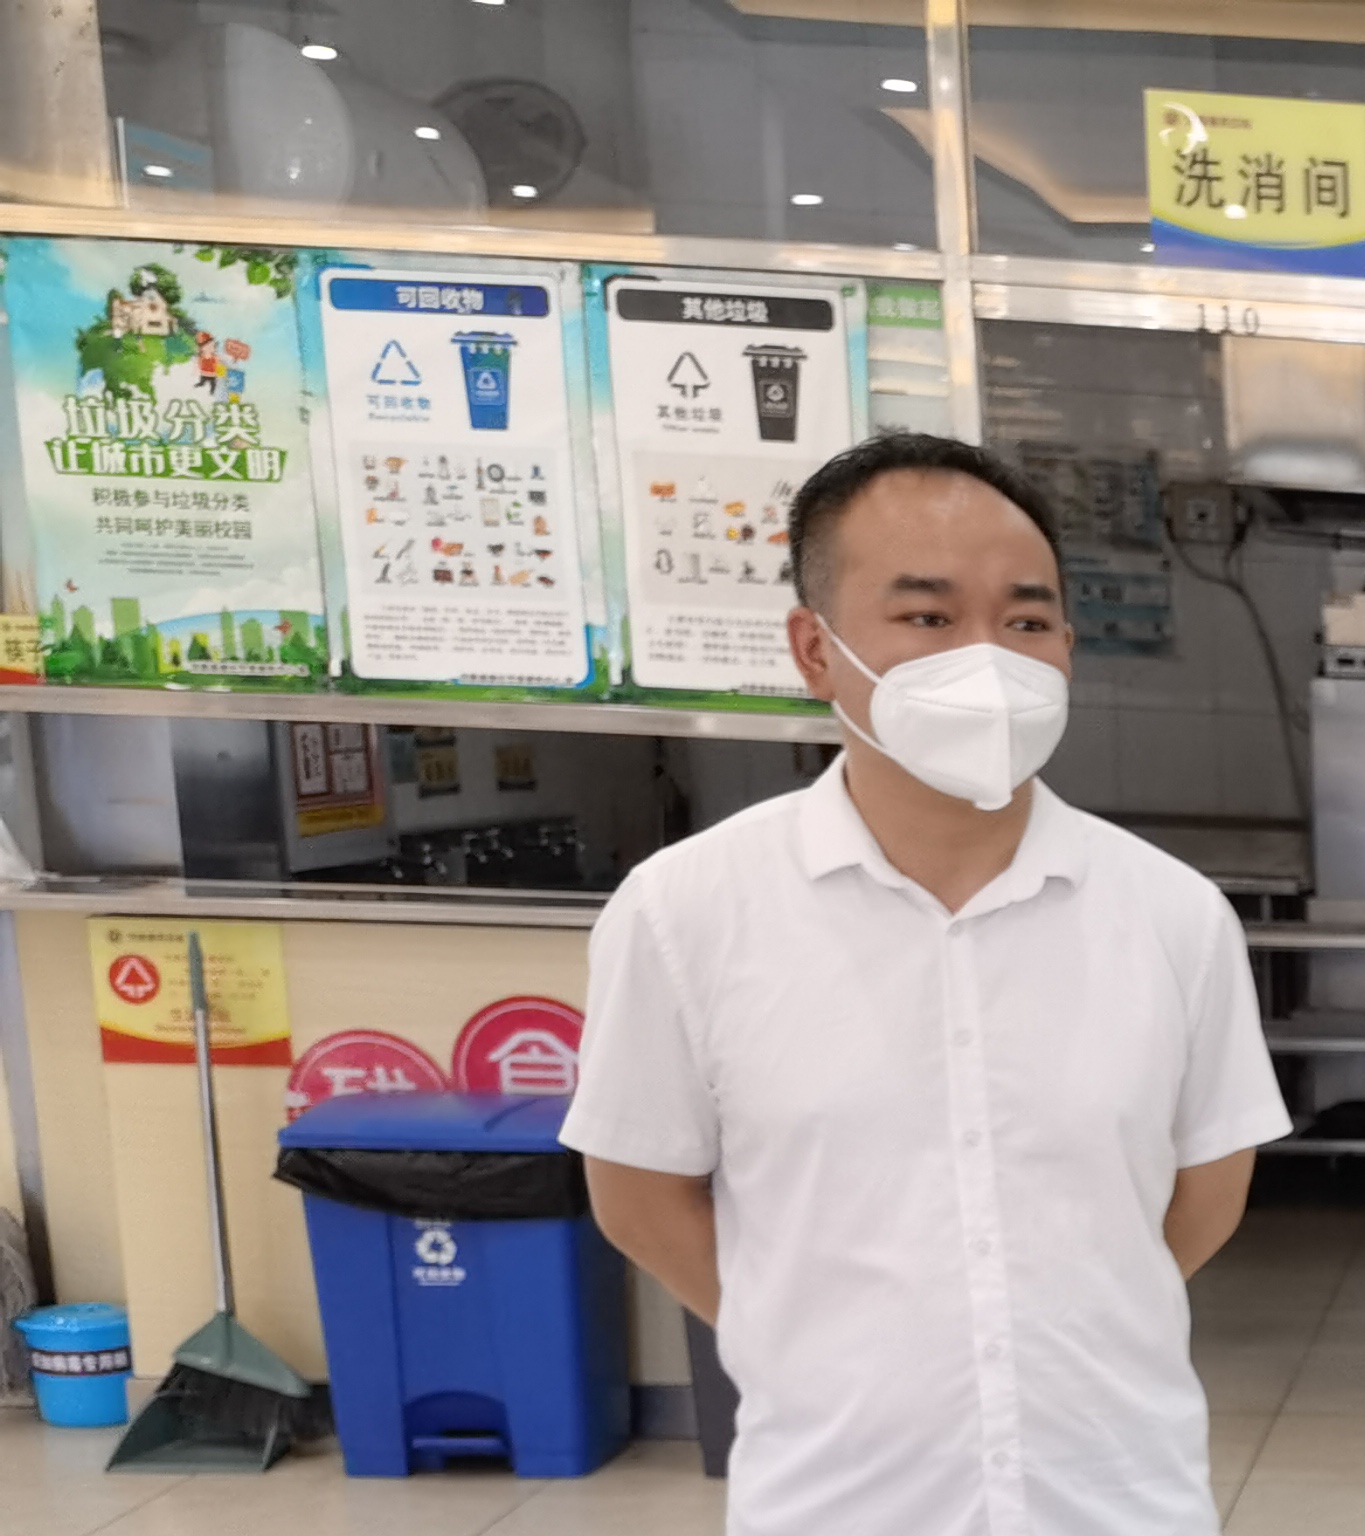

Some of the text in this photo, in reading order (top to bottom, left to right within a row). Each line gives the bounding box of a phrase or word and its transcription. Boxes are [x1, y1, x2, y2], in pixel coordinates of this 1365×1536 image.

[1172, 147, 1349, 219] 洗消间
[396, 286, 483, 314] 可回收物
[682, 297, 768, 323] 其他垃圾
[64, 395, 260, 447] 垃圾分类
[53, 438, 282, 481] 让城市更文明
[92, 487, 250, 512] 积极参与垃圾分类
[96, 517, 253, 540] 共同呵护美丽校园
